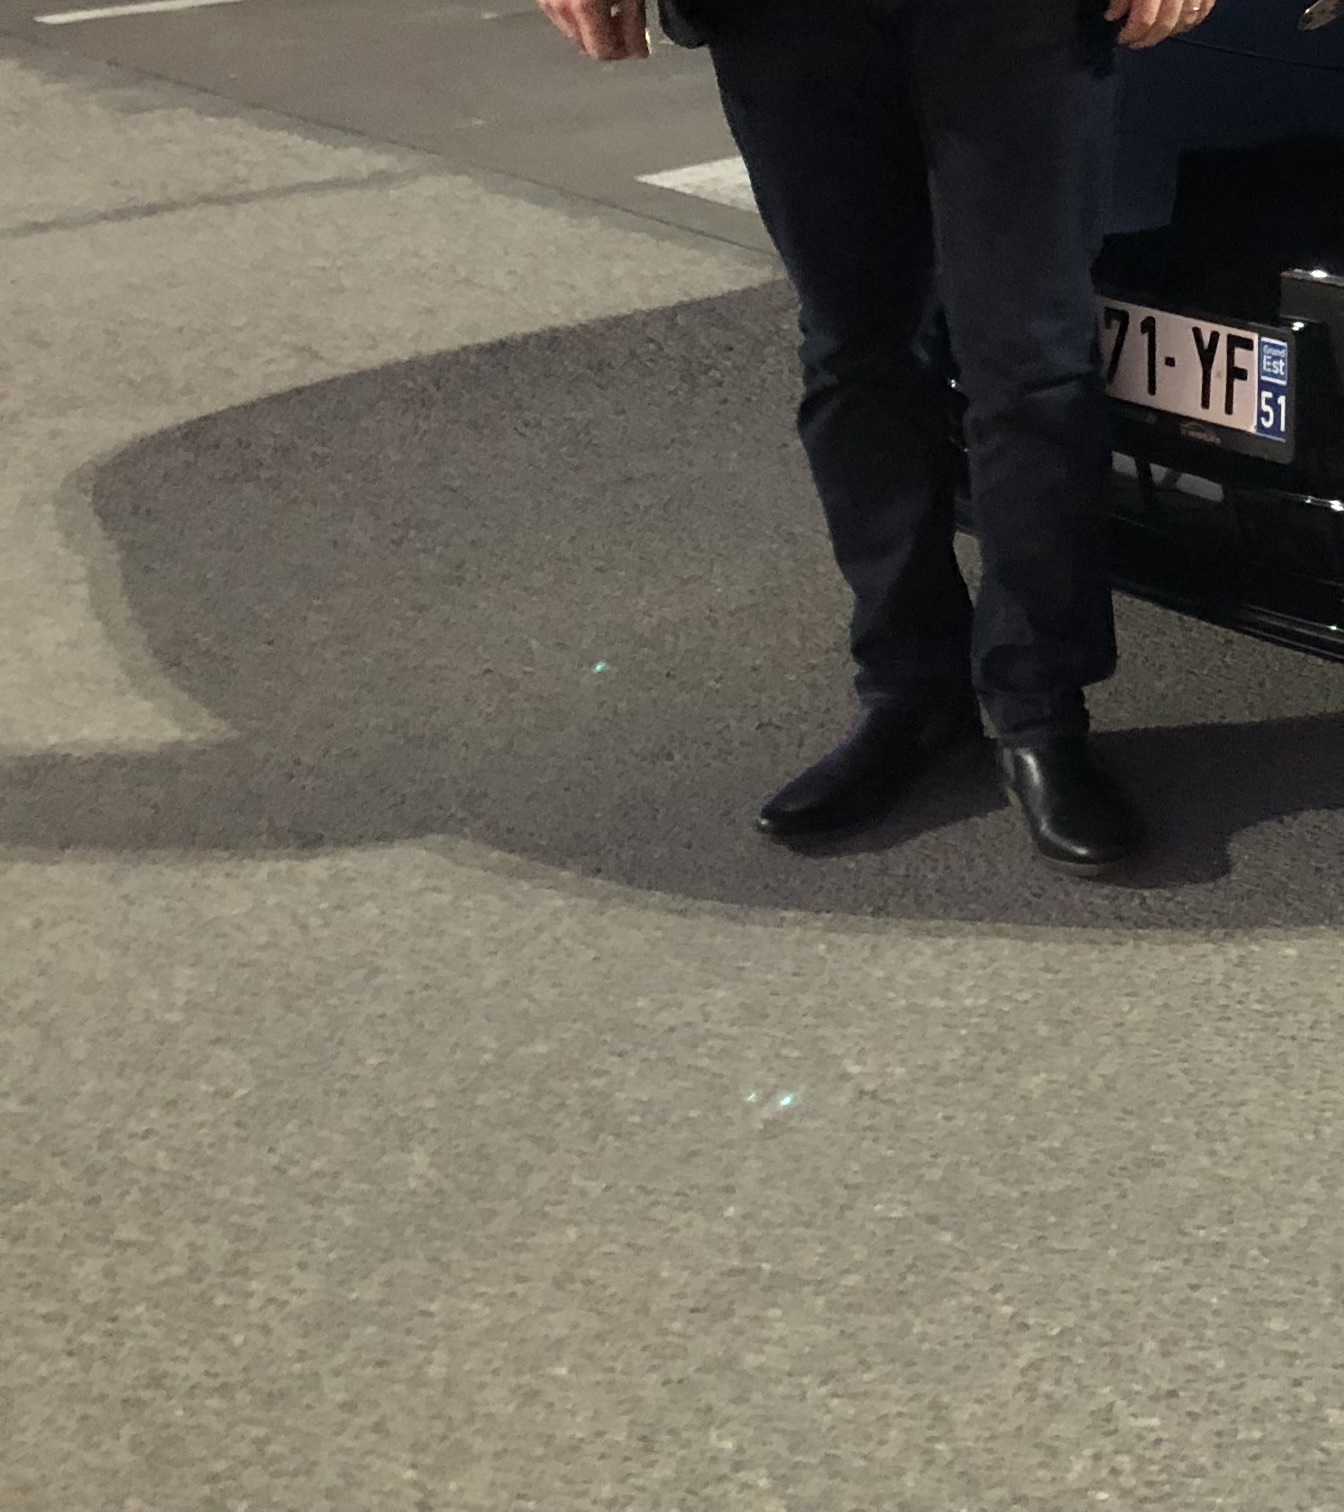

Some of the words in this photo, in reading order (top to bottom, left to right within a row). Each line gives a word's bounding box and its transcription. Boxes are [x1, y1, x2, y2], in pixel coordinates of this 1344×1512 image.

[1103, 306, 1254, 416] 71-YF
[1263, 354, 1285, 376] Est
[1260, 390, 1286, 432] 51
